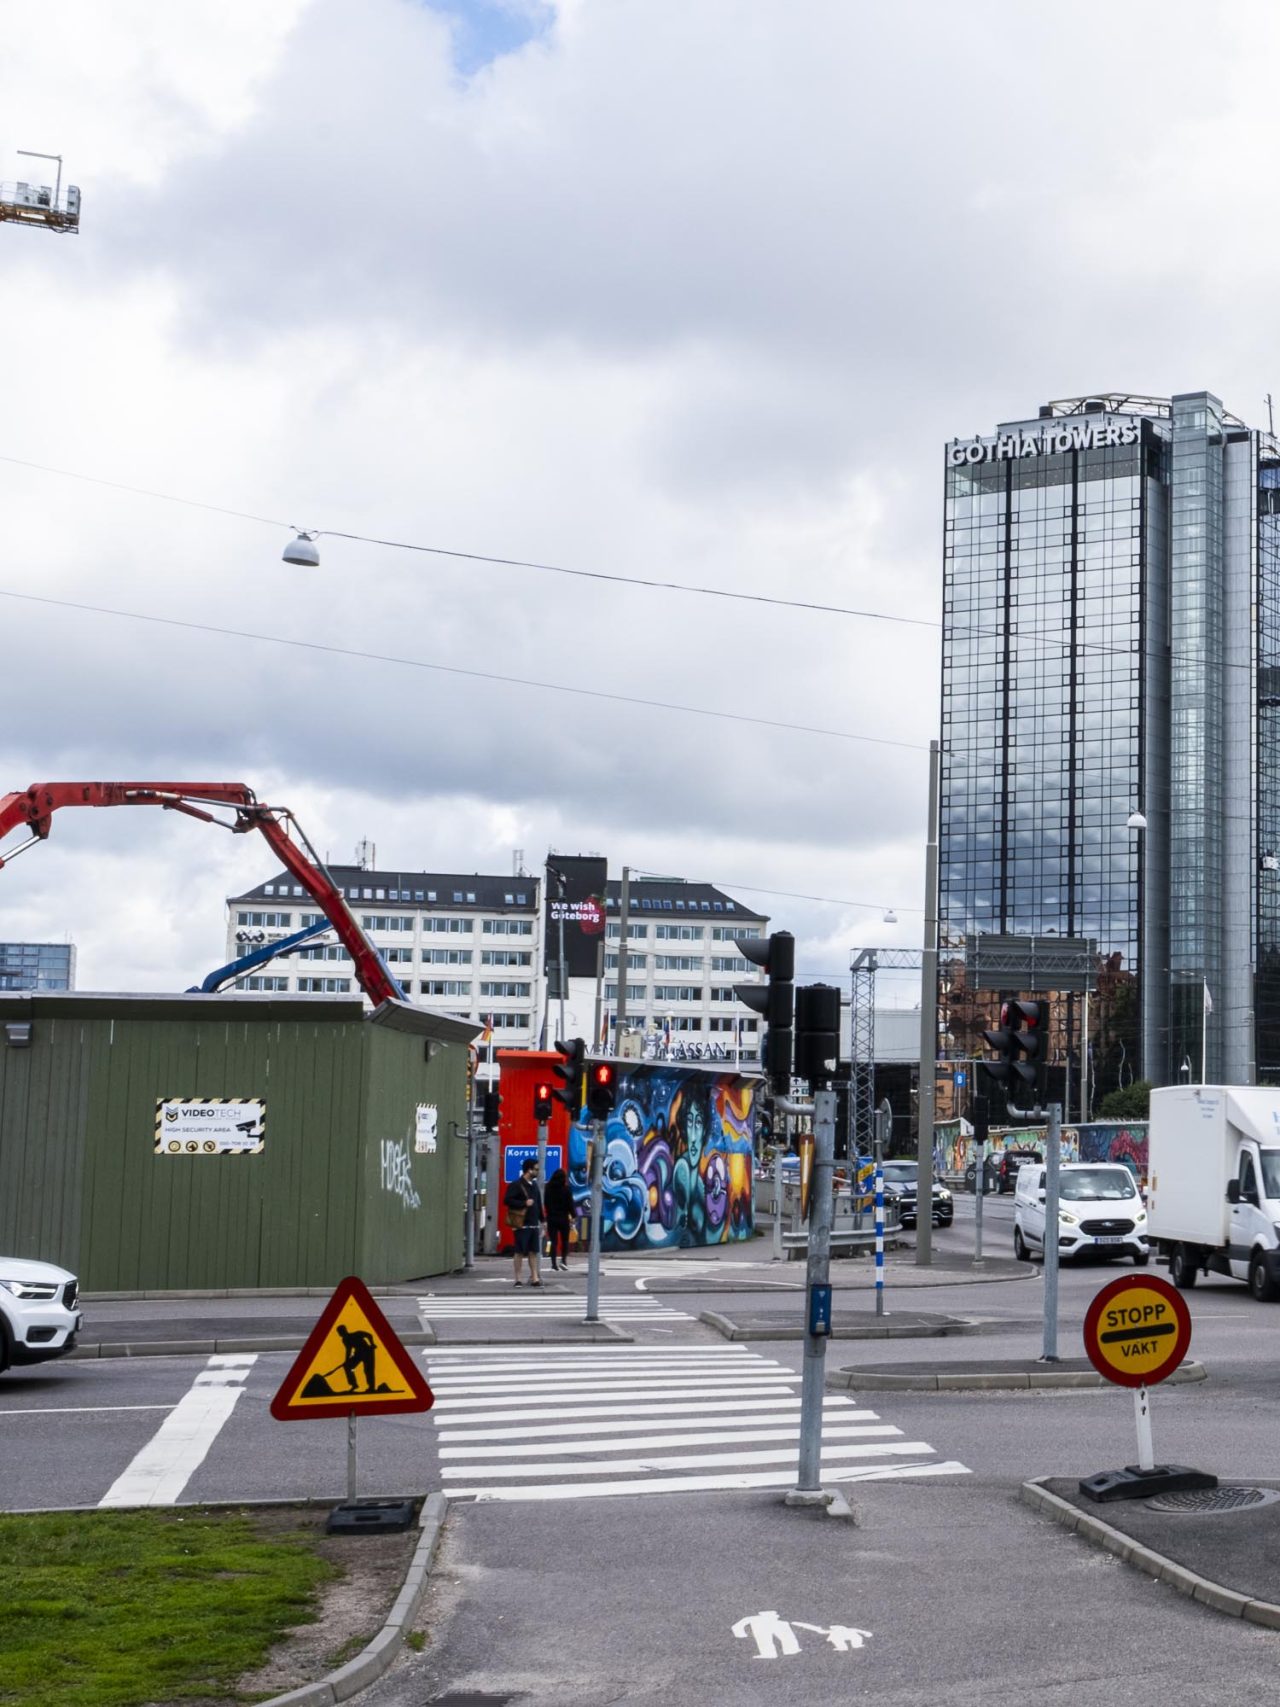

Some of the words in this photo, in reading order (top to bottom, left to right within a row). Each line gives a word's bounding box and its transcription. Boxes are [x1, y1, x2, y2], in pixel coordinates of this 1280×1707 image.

[950, 436, 1038, 466] GOTHIA
[1045, 423, 1137, 452] TOWERS
[551, 902, 568, 910] We
[570, 901, 595, 911] wish
[181, 1109, 241, 1118] VIDEOTECH
[508, 1149, 559, 1157] Korsven
[1106, 1304, 1166, 1328] STOPP
[1121, 1341, 1158, 1358] VAKT
